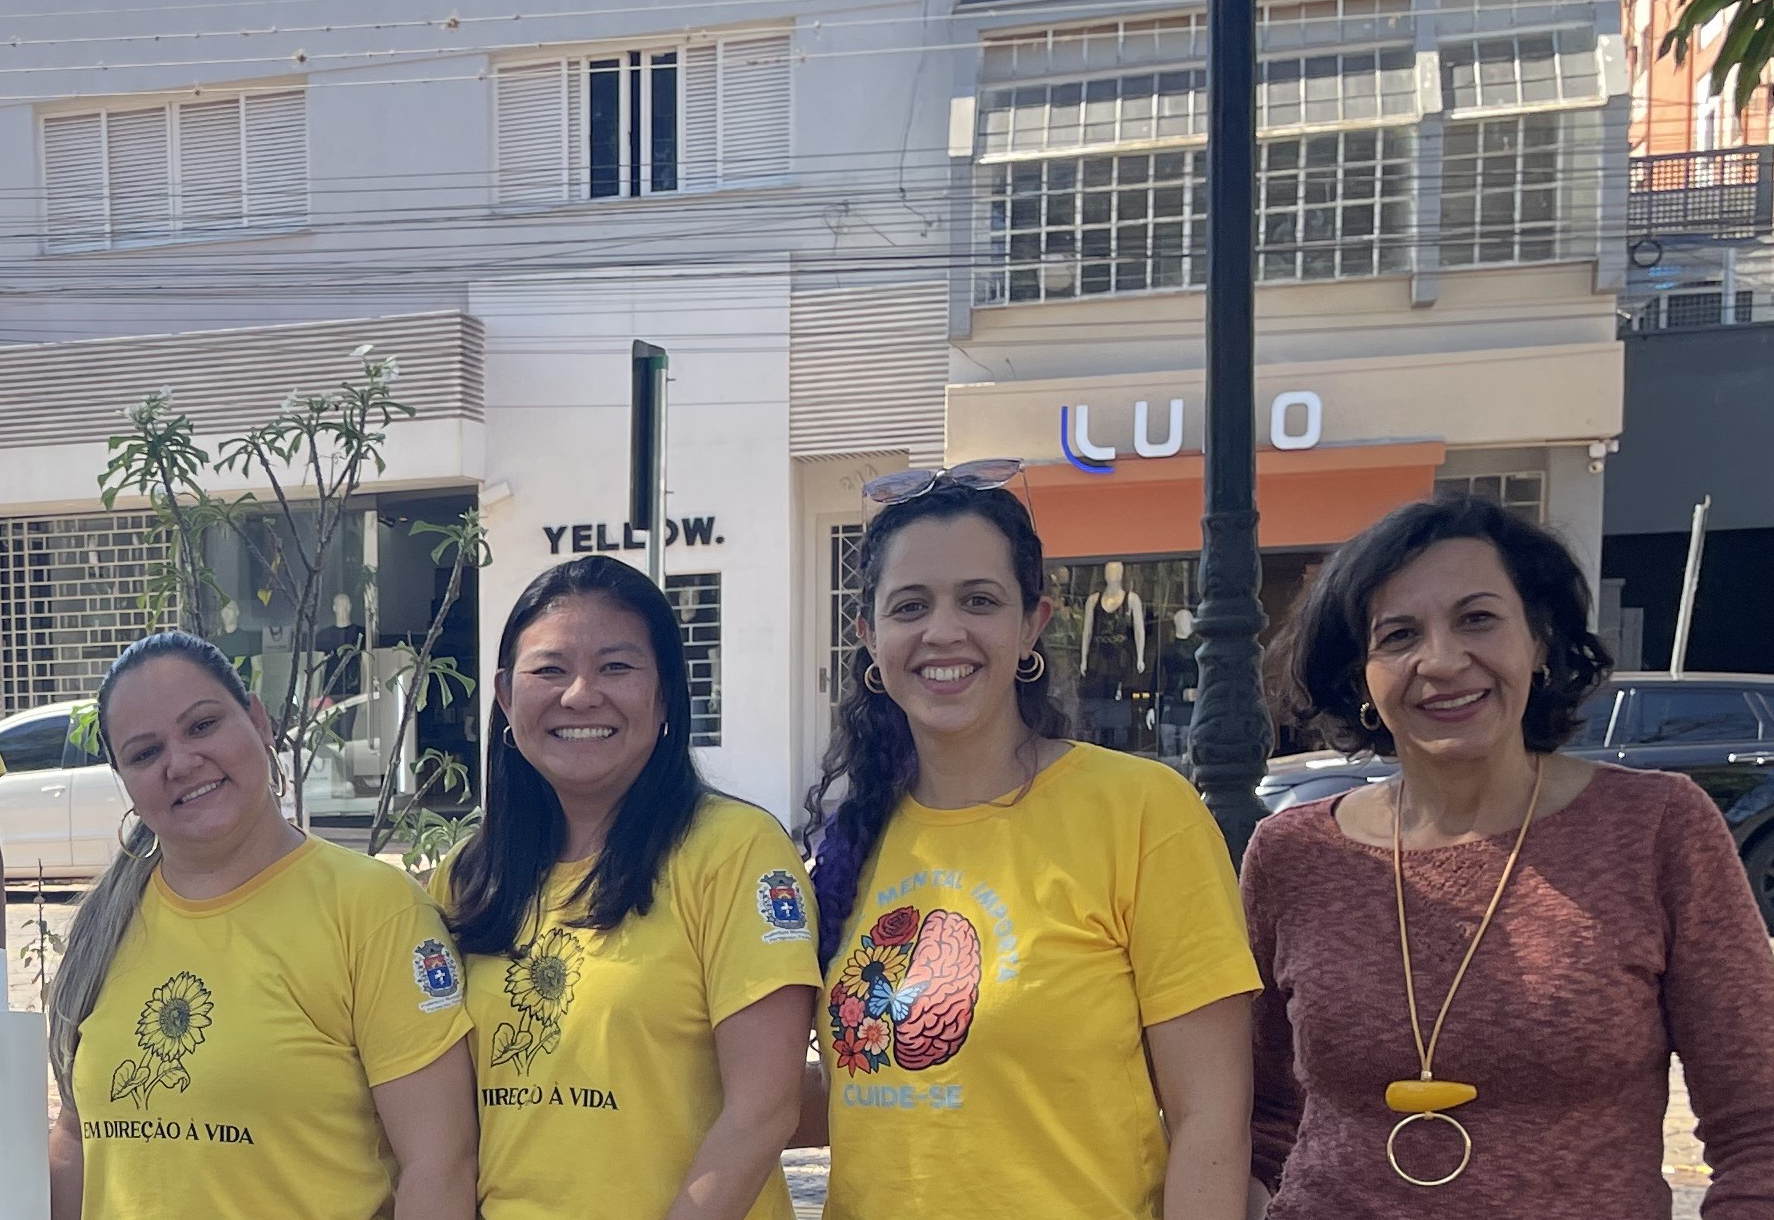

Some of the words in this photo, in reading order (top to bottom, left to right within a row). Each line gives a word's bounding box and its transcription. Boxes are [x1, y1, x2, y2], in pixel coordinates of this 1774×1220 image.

[1061, 390, 1322, 474] LUO
[569, 1087, 619, 1111] VIDA
[83, 1121, 102, 1139] EM
[104, 1117, 181, 1143] DIREÇÃO
[204, 1123, 255, 1145] VIDA
